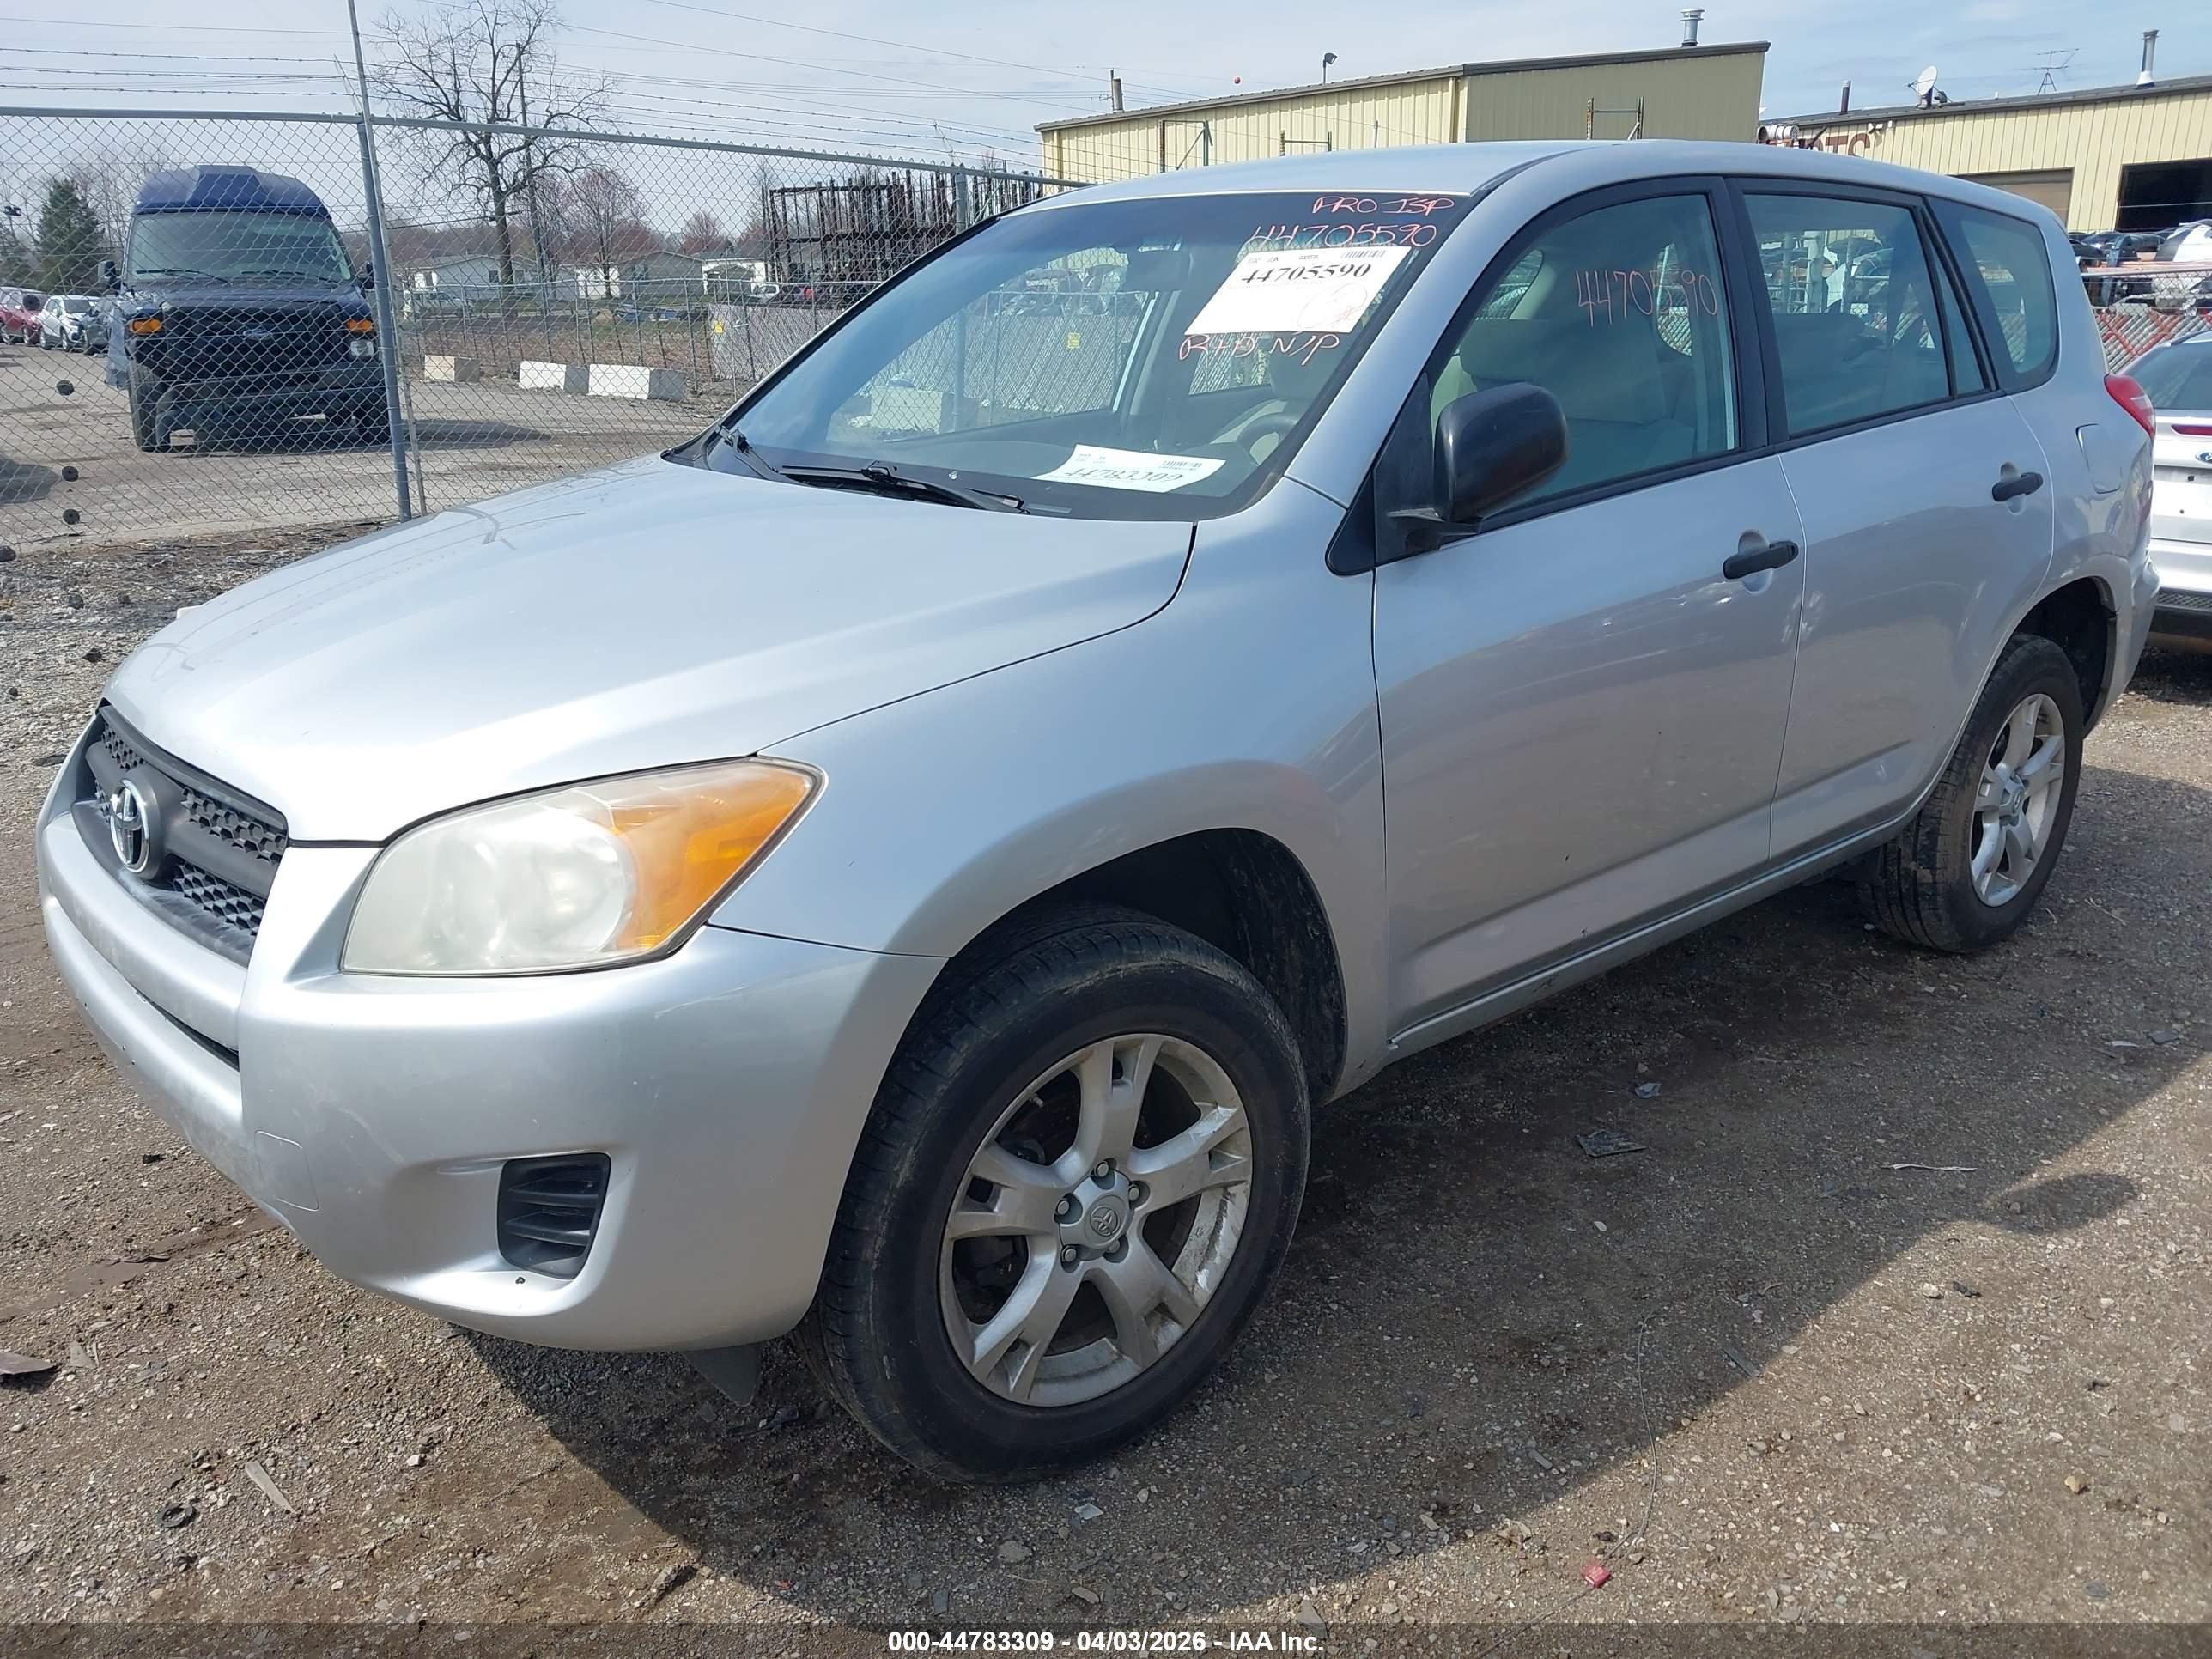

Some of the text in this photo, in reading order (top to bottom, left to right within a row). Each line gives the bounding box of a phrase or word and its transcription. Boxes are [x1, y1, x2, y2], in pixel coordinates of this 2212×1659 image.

[1312, 196, 1378, 214] PRO
[1251, 223, 1437, 249] 44705590
[1241, 263, 1371, 283] 44705590
[1575, 269, 1717, 328] 44705590
[1064, 467, 1184, 483] 44783309
